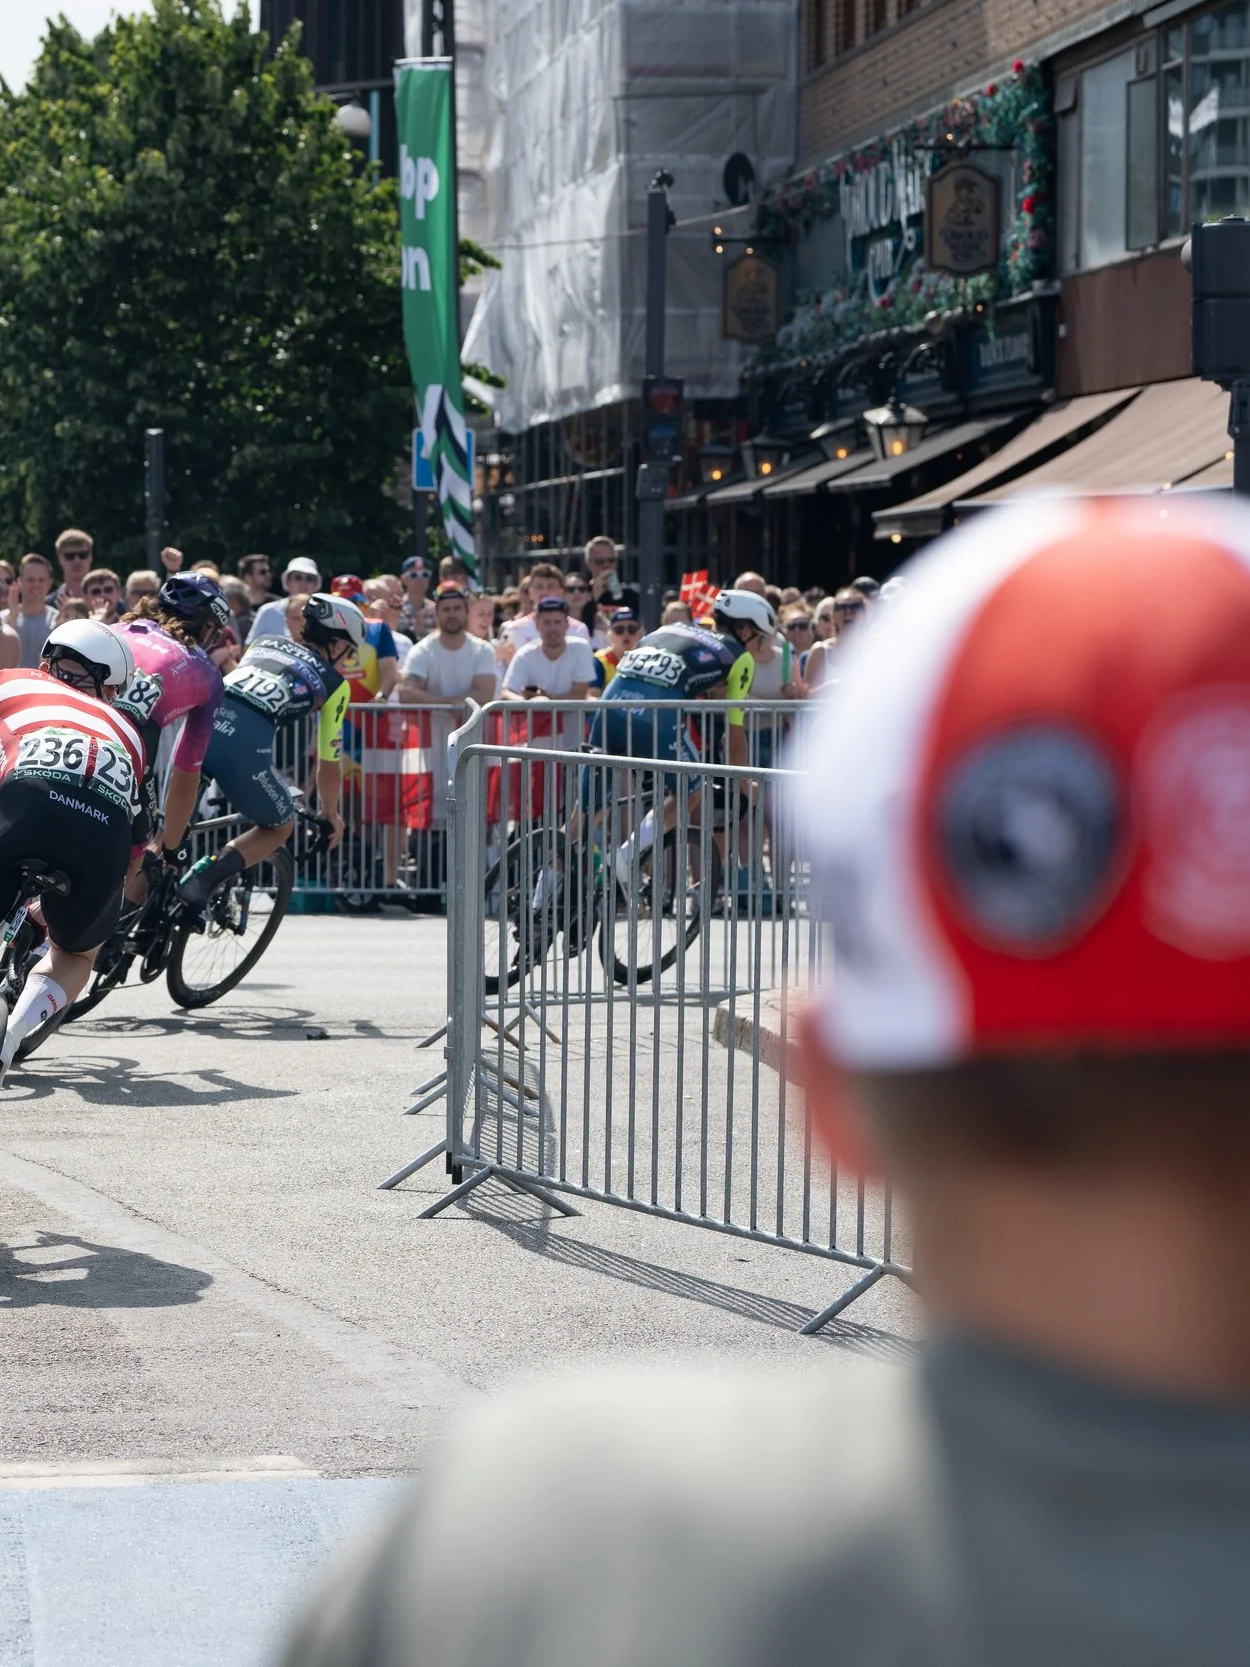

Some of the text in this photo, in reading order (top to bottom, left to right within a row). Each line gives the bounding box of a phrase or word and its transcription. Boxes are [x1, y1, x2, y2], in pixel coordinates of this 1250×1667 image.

[213, 720, 236, 736] alia
[19, 737, 84, 770] 236
[49, 790, 111, 825] DANMARK
